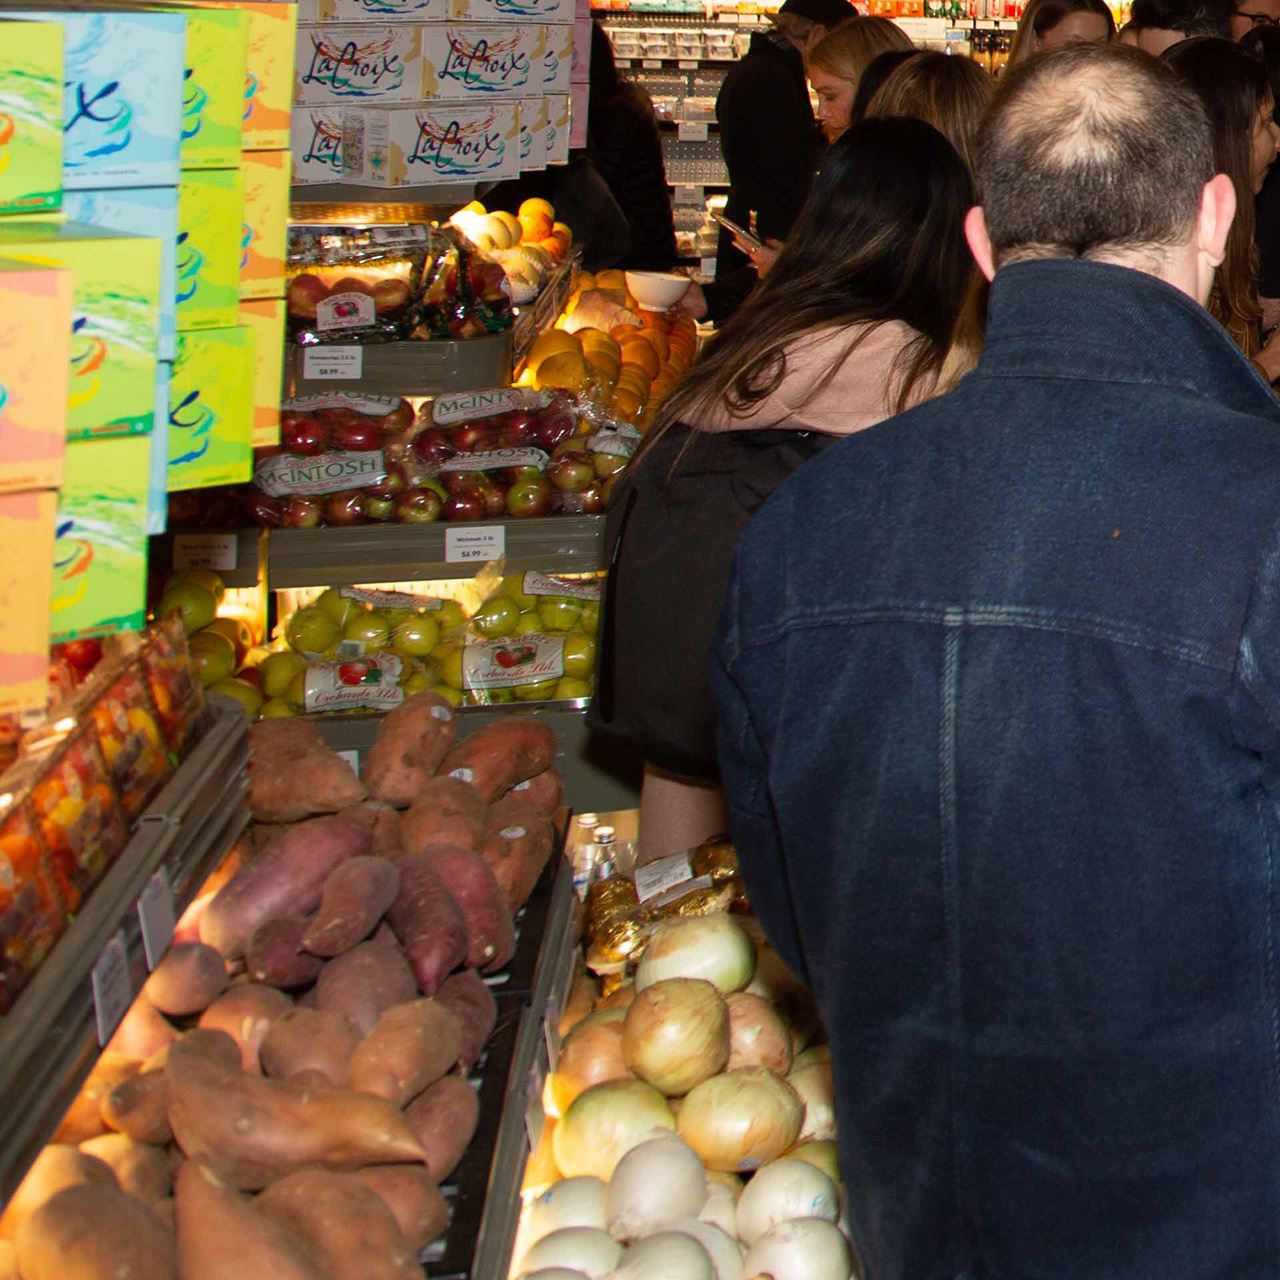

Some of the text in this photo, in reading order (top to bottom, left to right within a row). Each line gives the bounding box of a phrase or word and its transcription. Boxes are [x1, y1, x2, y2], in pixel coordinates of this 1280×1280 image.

[302, 40, 399, 89] LaCroix
[438, 39, 526, 85] LaCroix
[407, 121, 500, 168] LaCroix
[437, 388, 523, 414] McINT
[255, 459, 376, 485] McINTOSH
[314, 687, 398, 705] Orchards Ltd.
